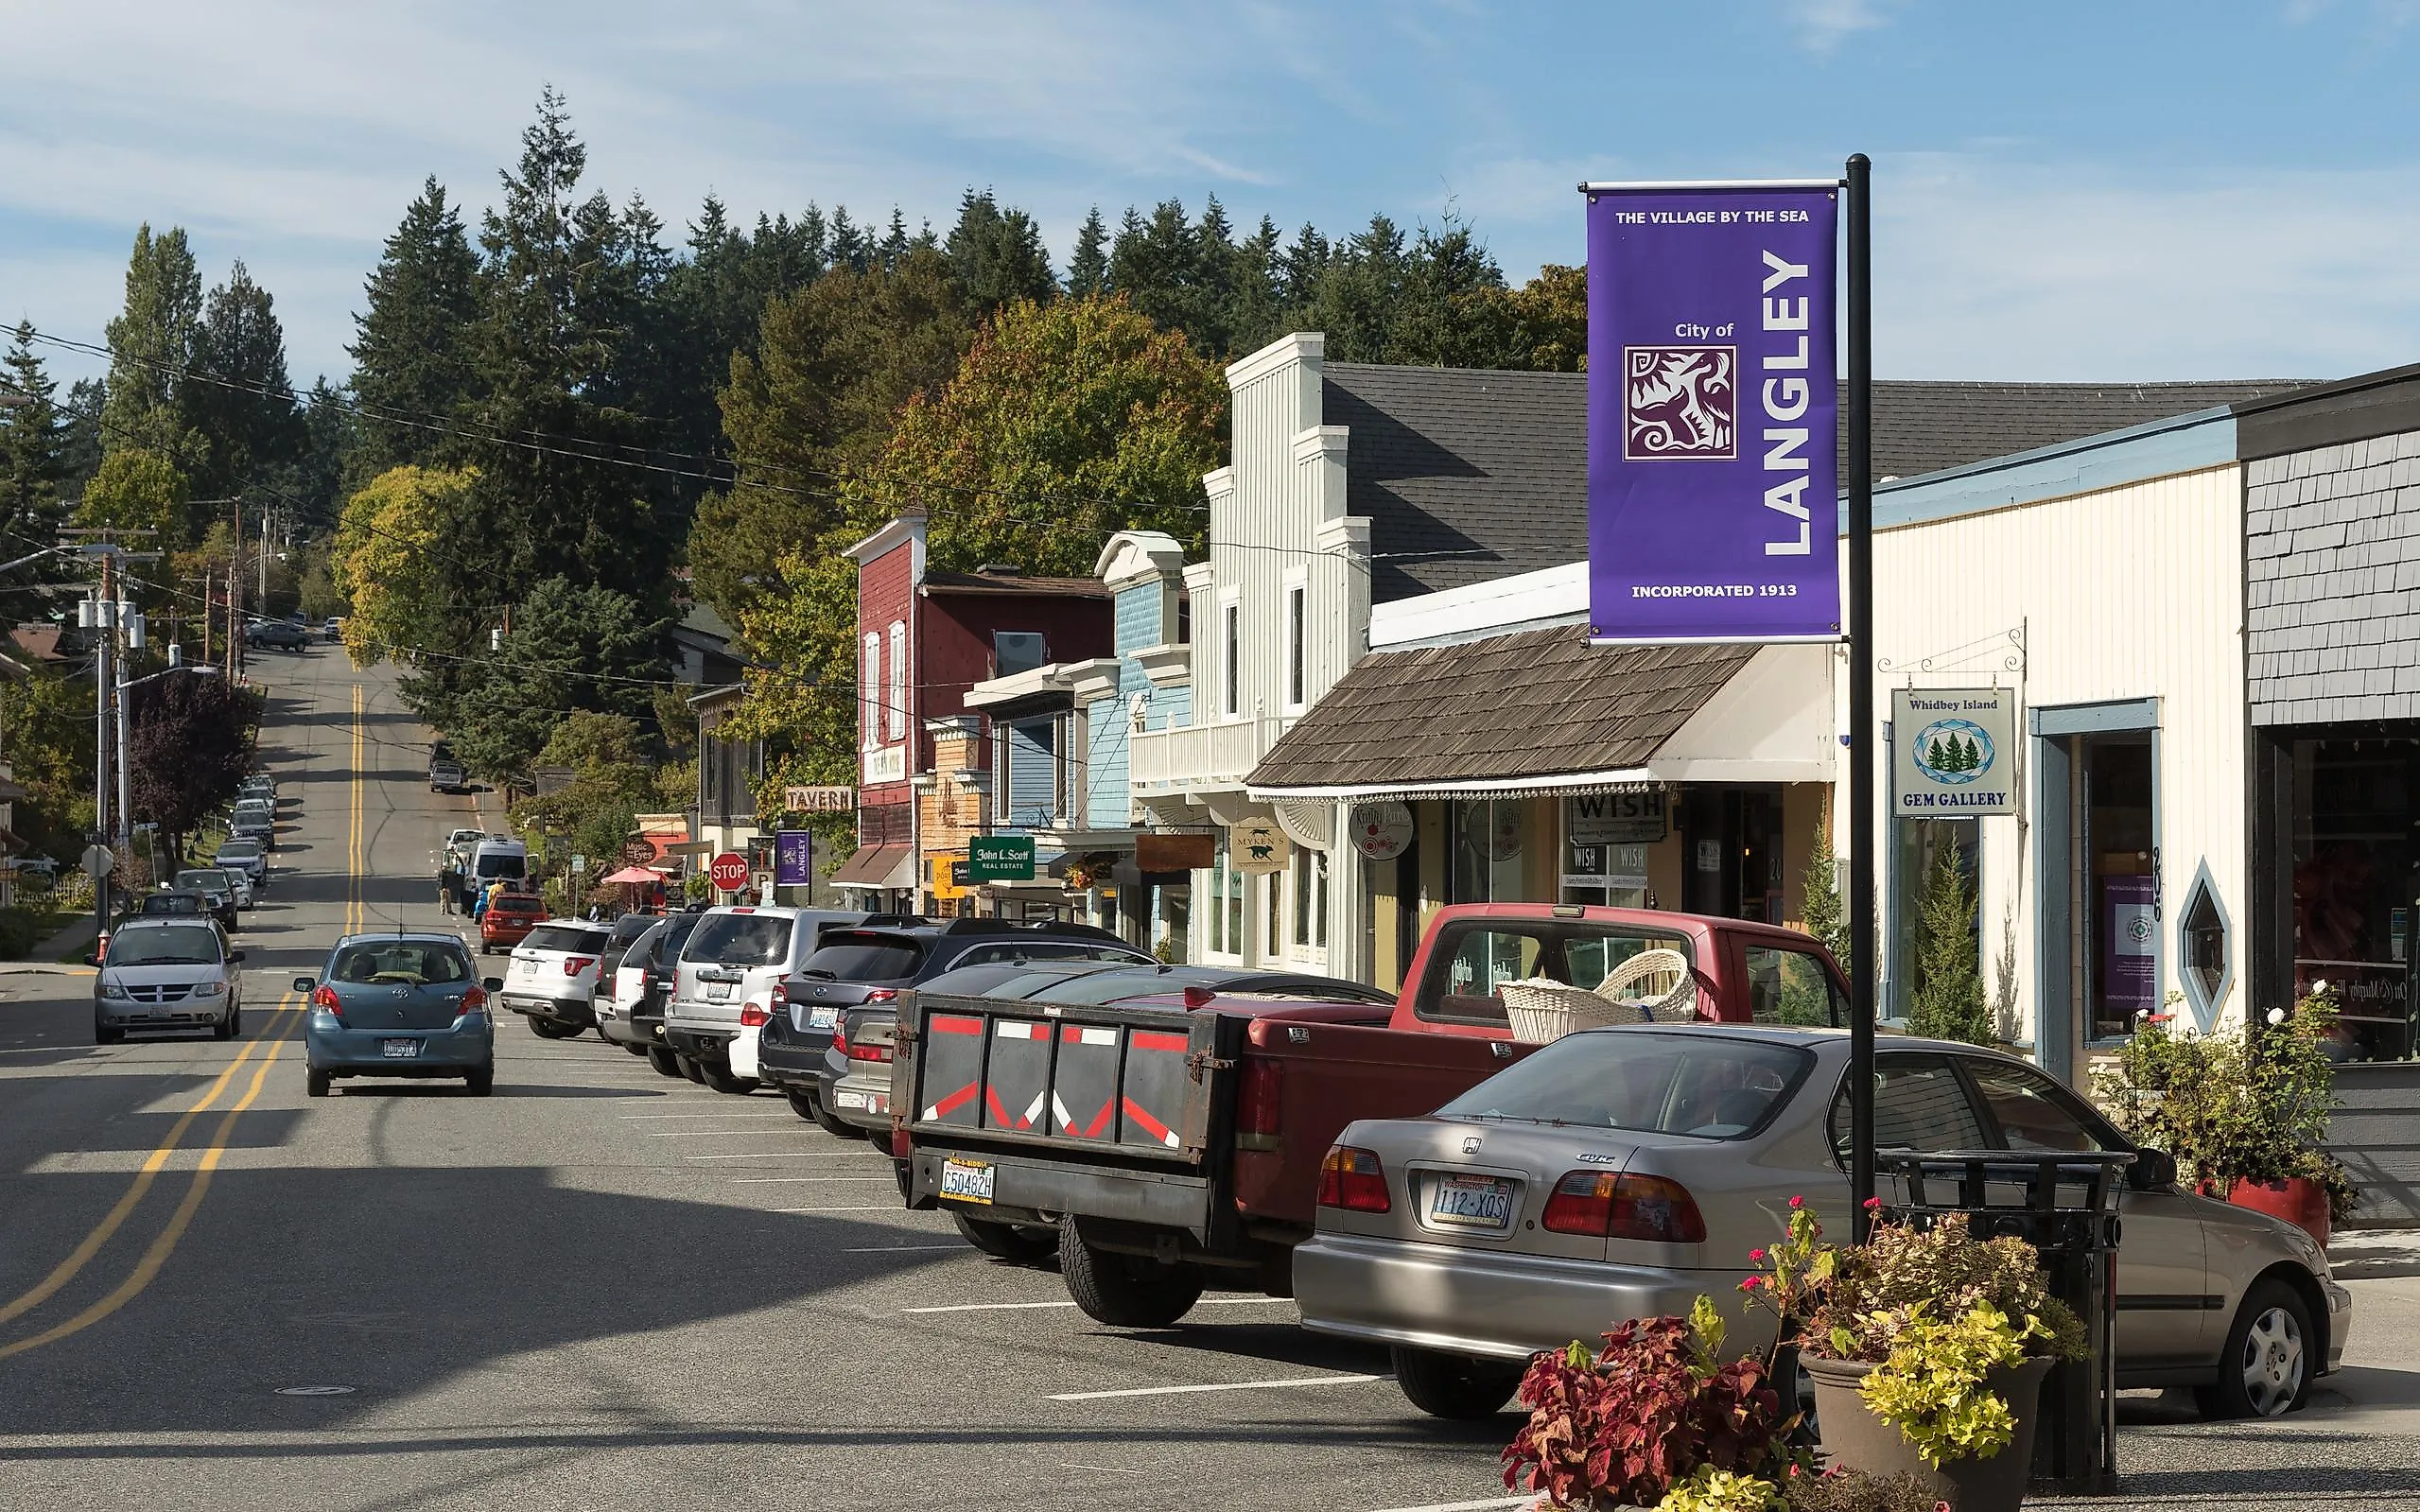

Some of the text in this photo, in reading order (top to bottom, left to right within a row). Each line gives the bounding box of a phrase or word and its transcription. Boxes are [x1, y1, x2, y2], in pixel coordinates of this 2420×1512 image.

[1615, 210, 1809, 224] THE VILLAGE BY THE SEA
[1675, 322, 1734, 340] City of
[1762, 249, 1811, 556] LANGLEY
[1631, 584, 1797, 598] INCORPORATED 1913
[1909, 700, 1998, 711] Whidbey Island
[788, 790, 849, 810] TAVERN
[1576, 793, 1661, 819] WISH
[1903, 792, 2007, 807] GEM GALLERY
[626, 842, 648, 851] Music
[1237, 837, 1285, 846] MYKENS
[634, 850, 653, 862] Eyes
[976, 849, 998, 861] John
[1008, 849, 1029, 860] Scott
[1574, 847, 1595, 867] WISH
[1620, 847, 1644, 867] WISH
[713, 864, 745, 880] STOP
[2153, 845, 2162, 923] 206
[944, 1172, 992, 1196] C50482H
[1444, 1181, 1485, 1191] WASHINGTON
